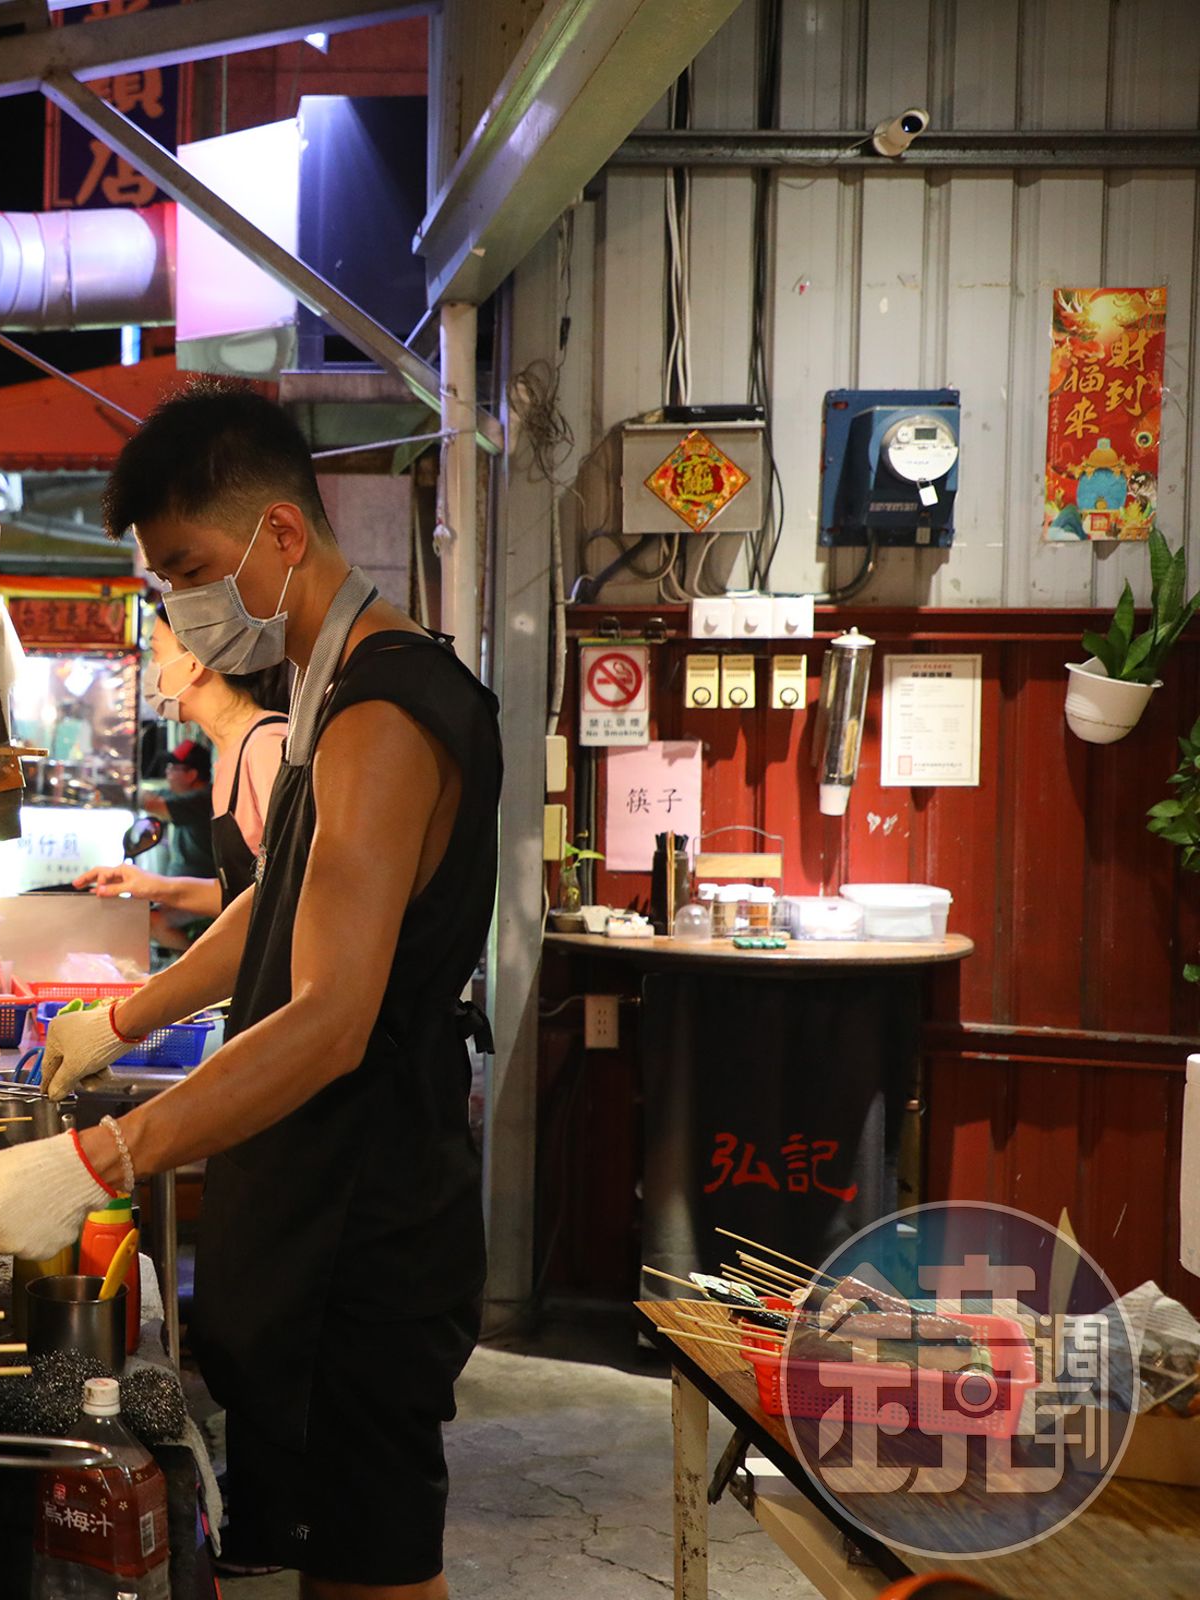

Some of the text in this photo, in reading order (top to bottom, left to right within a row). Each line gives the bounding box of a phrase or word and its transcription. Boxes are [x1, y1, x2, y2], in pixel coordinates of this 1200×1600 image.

[1063, 355, 1106, 439] 福來
[1105, 329, 1150, 417] 財到
[604, 729, 644, 737] Smoking
[626, 787, 682, 814] 筷子
[704, 1132, 858, 1201] 弘記
[43, 1500, 114, 1538] 烏梅汁
